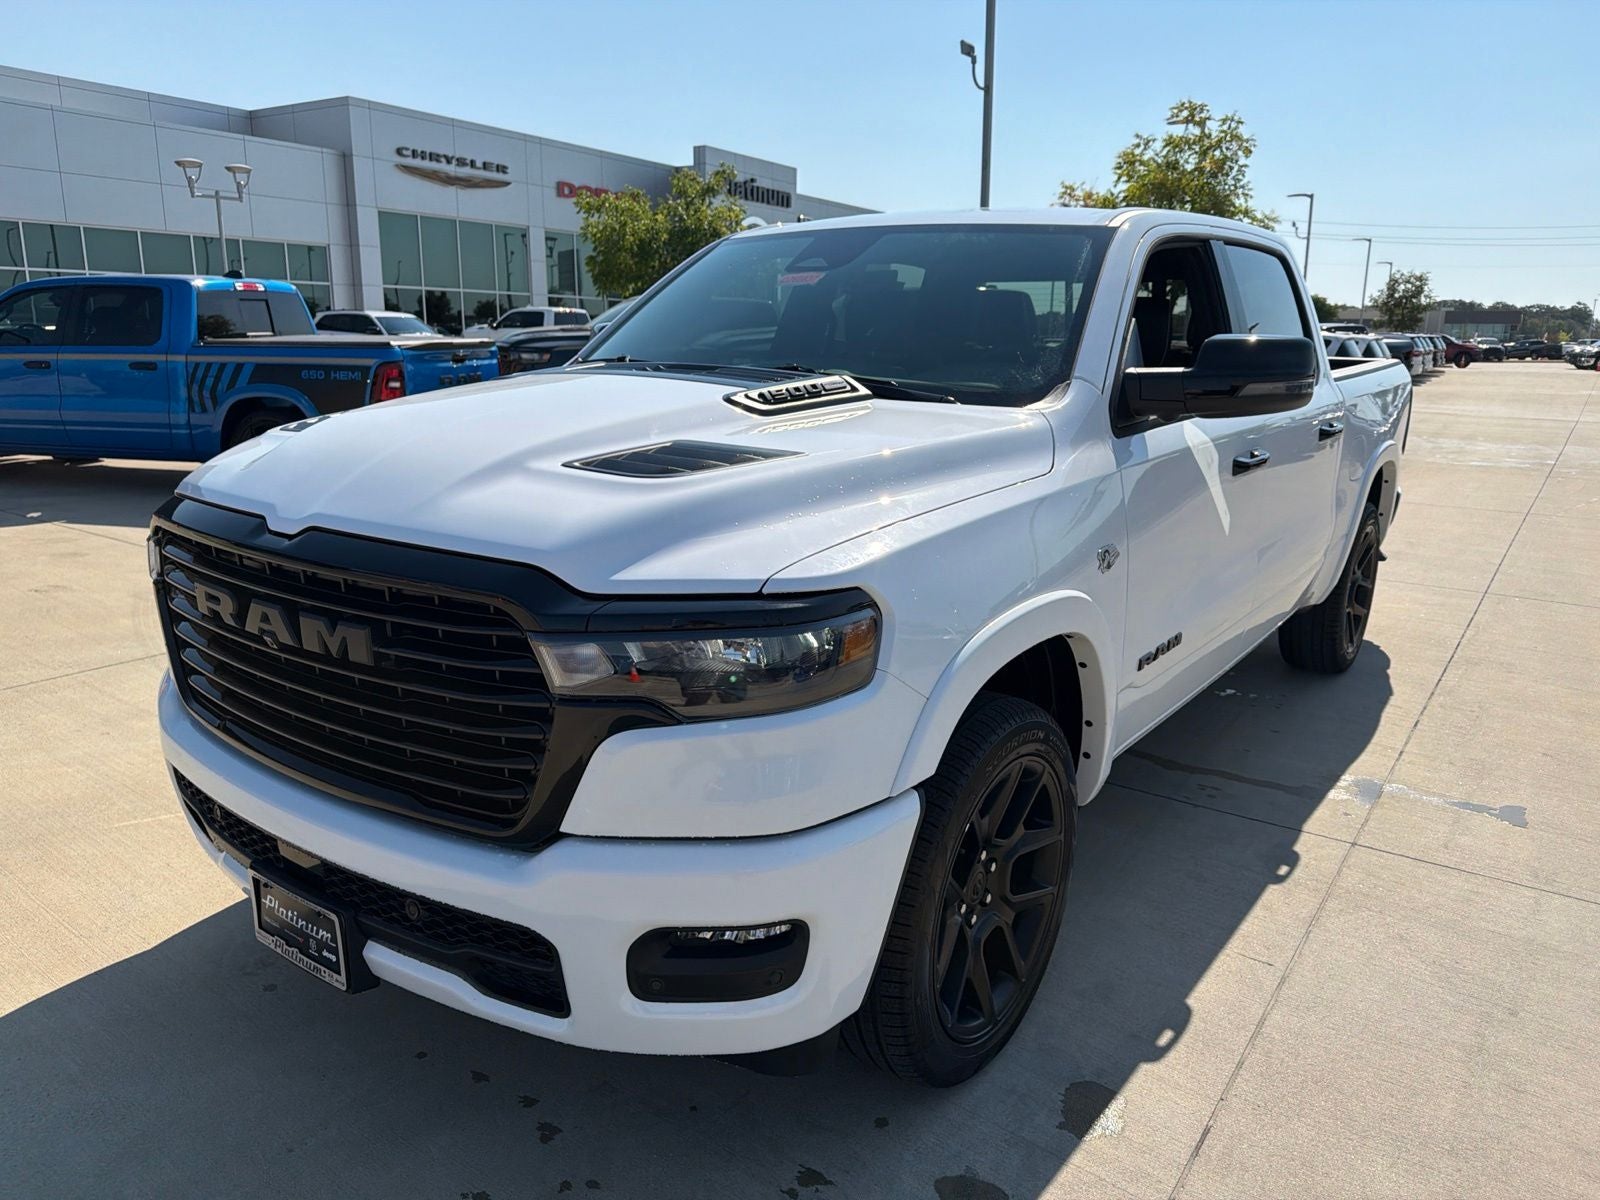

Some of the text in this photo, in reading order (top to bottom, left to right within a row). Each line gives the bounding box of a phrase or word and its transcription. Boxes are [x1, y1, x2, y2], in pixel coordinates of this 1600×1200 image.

[395, 146, 510, 175] CHRYSLER
[724, 177, 792, 208] latinum
[301, 370, 362, 381] 650 HEMI
[758, 383, 823, 404] 1500
[194, 581, 375, 667] RAM
[1137, 631, 1183, 672] RAM
[261, 894, 337, 947] Platinum
[273, 939, 327, 979] Platinum
